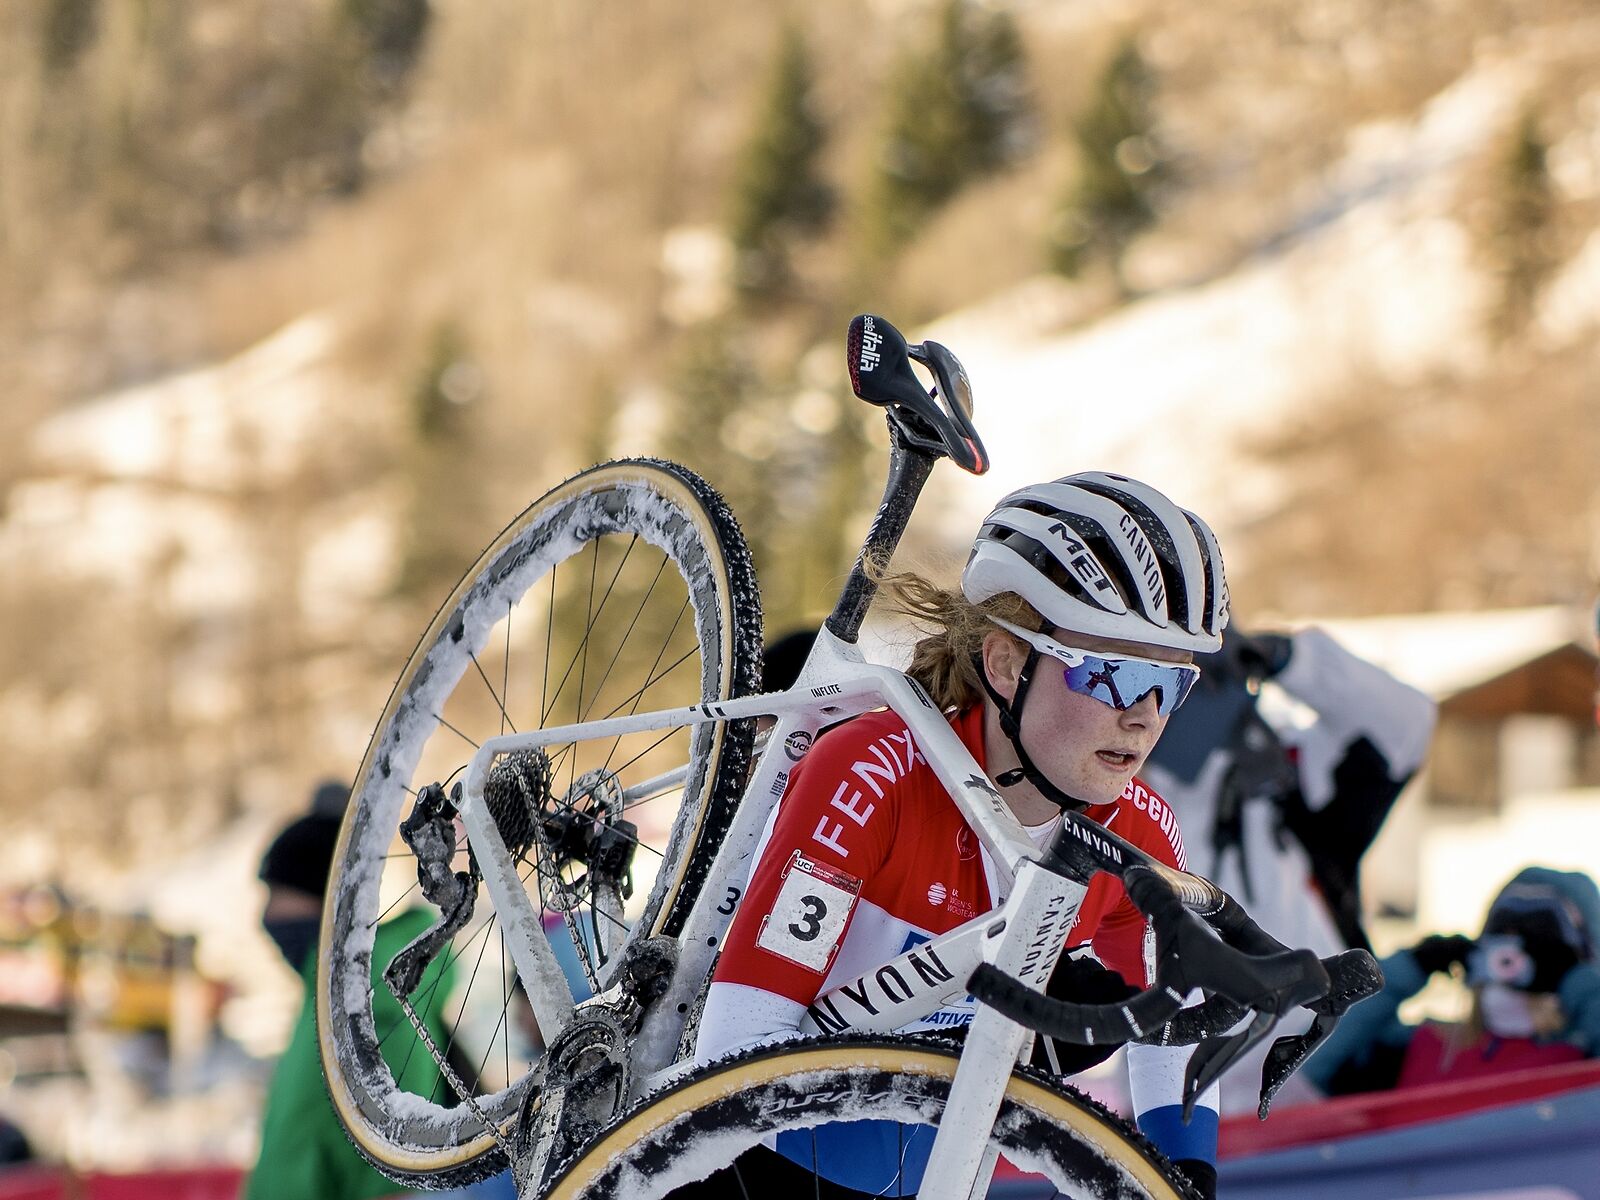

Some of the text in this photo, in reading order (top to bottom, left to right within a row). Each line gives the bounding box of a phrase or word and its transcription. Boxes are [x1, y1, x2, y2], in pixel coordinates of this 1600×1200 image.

[1048, 522, 1118, 595] MET
[1119, 514, 1165, 611] CANYON
[810, 683, 842, 698] INFLITE
[811, 729, 926, 858] FENIX
[1063, 816, 1123, 865] CANYON
[797, 860, 813, 871] UCI
[717, 887, 741, 915] 3
[788, 895, 828, 942] 3
[1018, 896, 1066, 977] CANYON
[1035, 902, 1079, 985] CANYON
[920, 1011, 975, 1026] ATIVE
